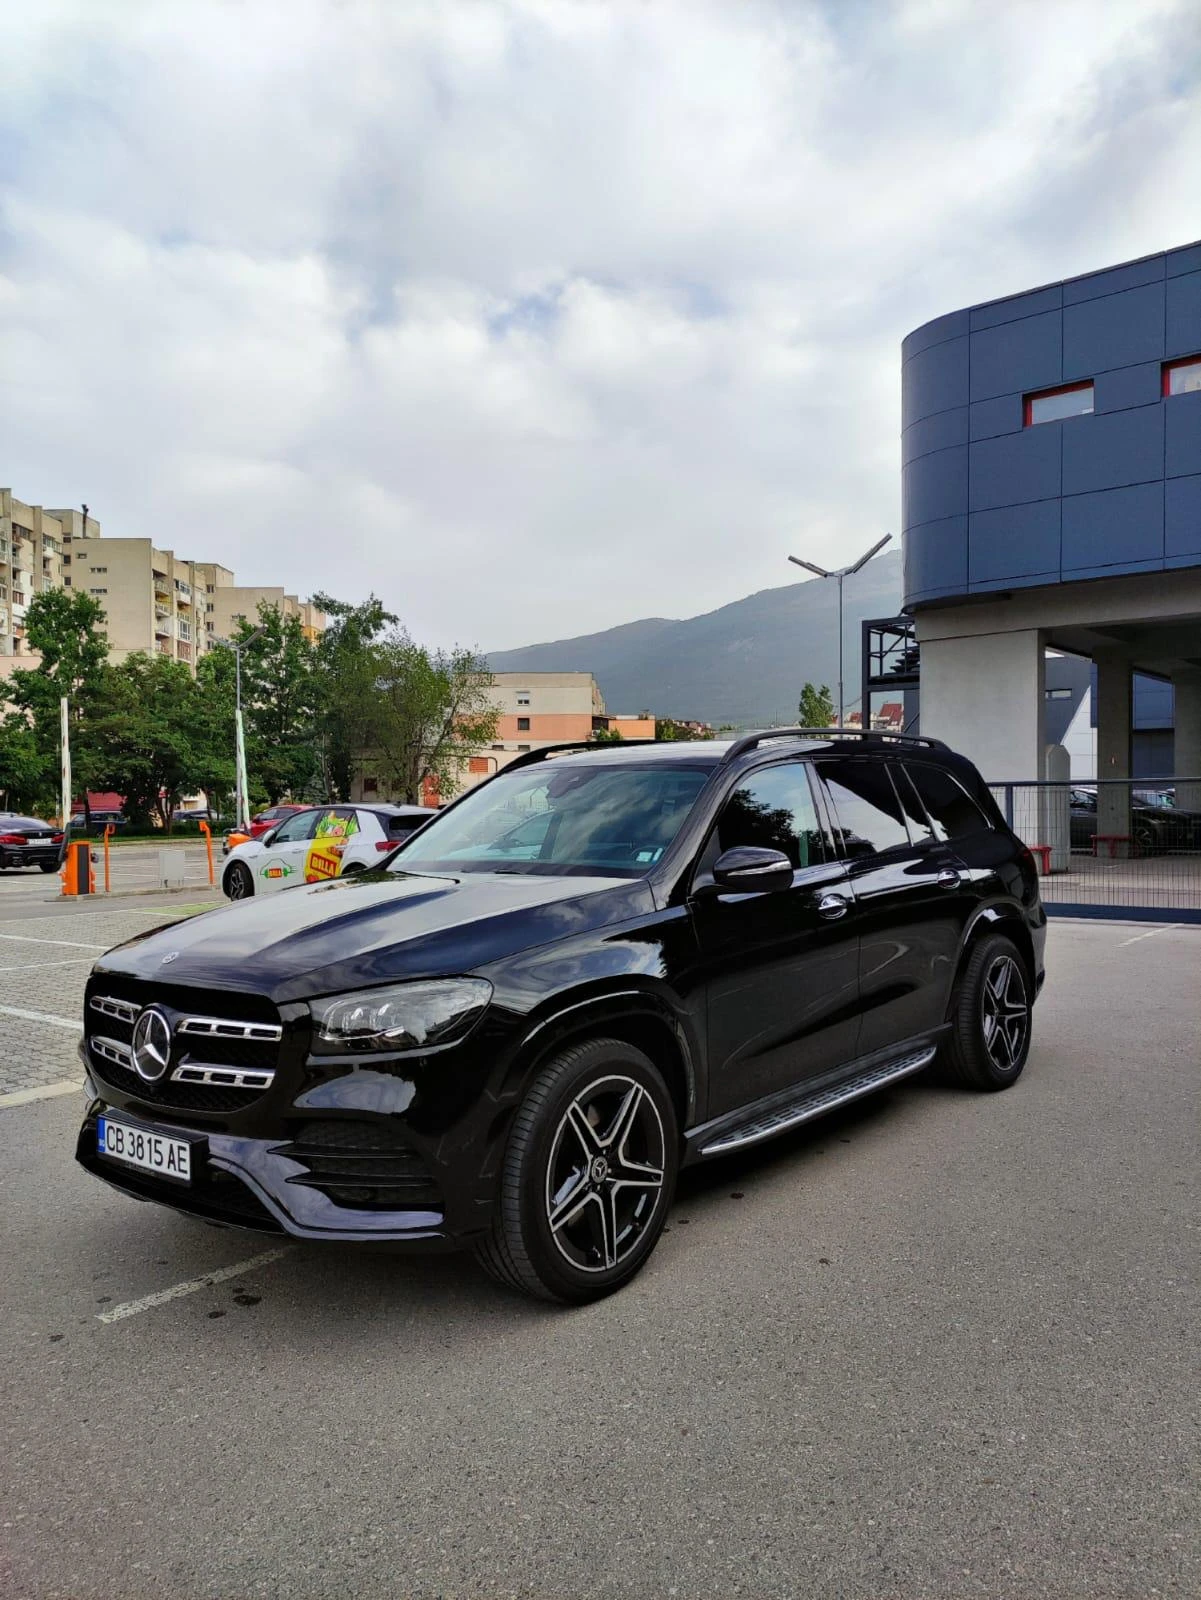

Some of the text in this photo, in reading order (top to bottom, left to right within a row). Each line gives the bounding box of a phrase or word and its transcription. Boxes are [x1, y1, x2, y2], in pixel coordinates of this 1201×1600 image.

[312, 856, 334, 876] BILLA
[106, 1125, 125, 1154] CB
[127, 1132, 164, 1166] 3815
[167, 1143, 188, 1174] AE
